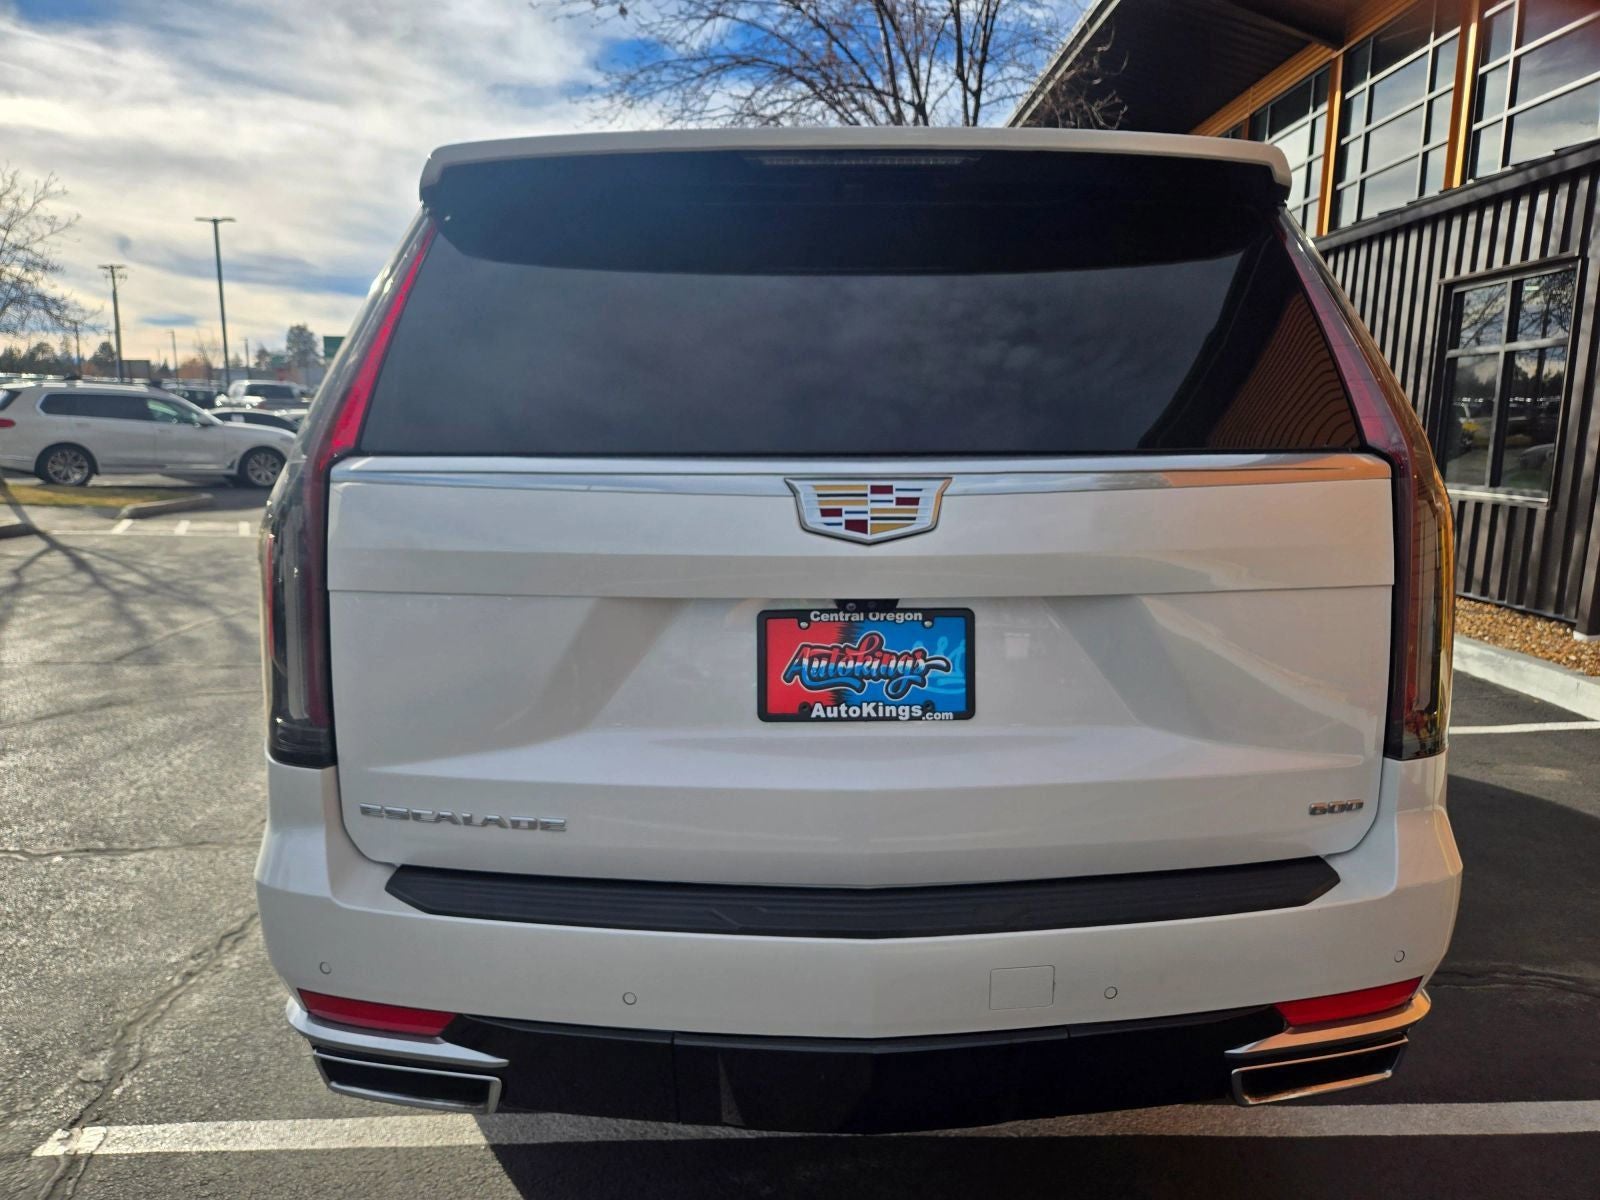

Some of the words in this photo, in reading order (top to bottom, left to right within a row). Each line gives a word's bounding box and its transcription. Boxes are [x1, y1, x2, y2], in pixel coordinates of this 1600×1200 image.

[810, 610, 864, 621] Central
[868, 611, 923, 624] Oregon
[359, 803, 567, 832] ESCALADE
